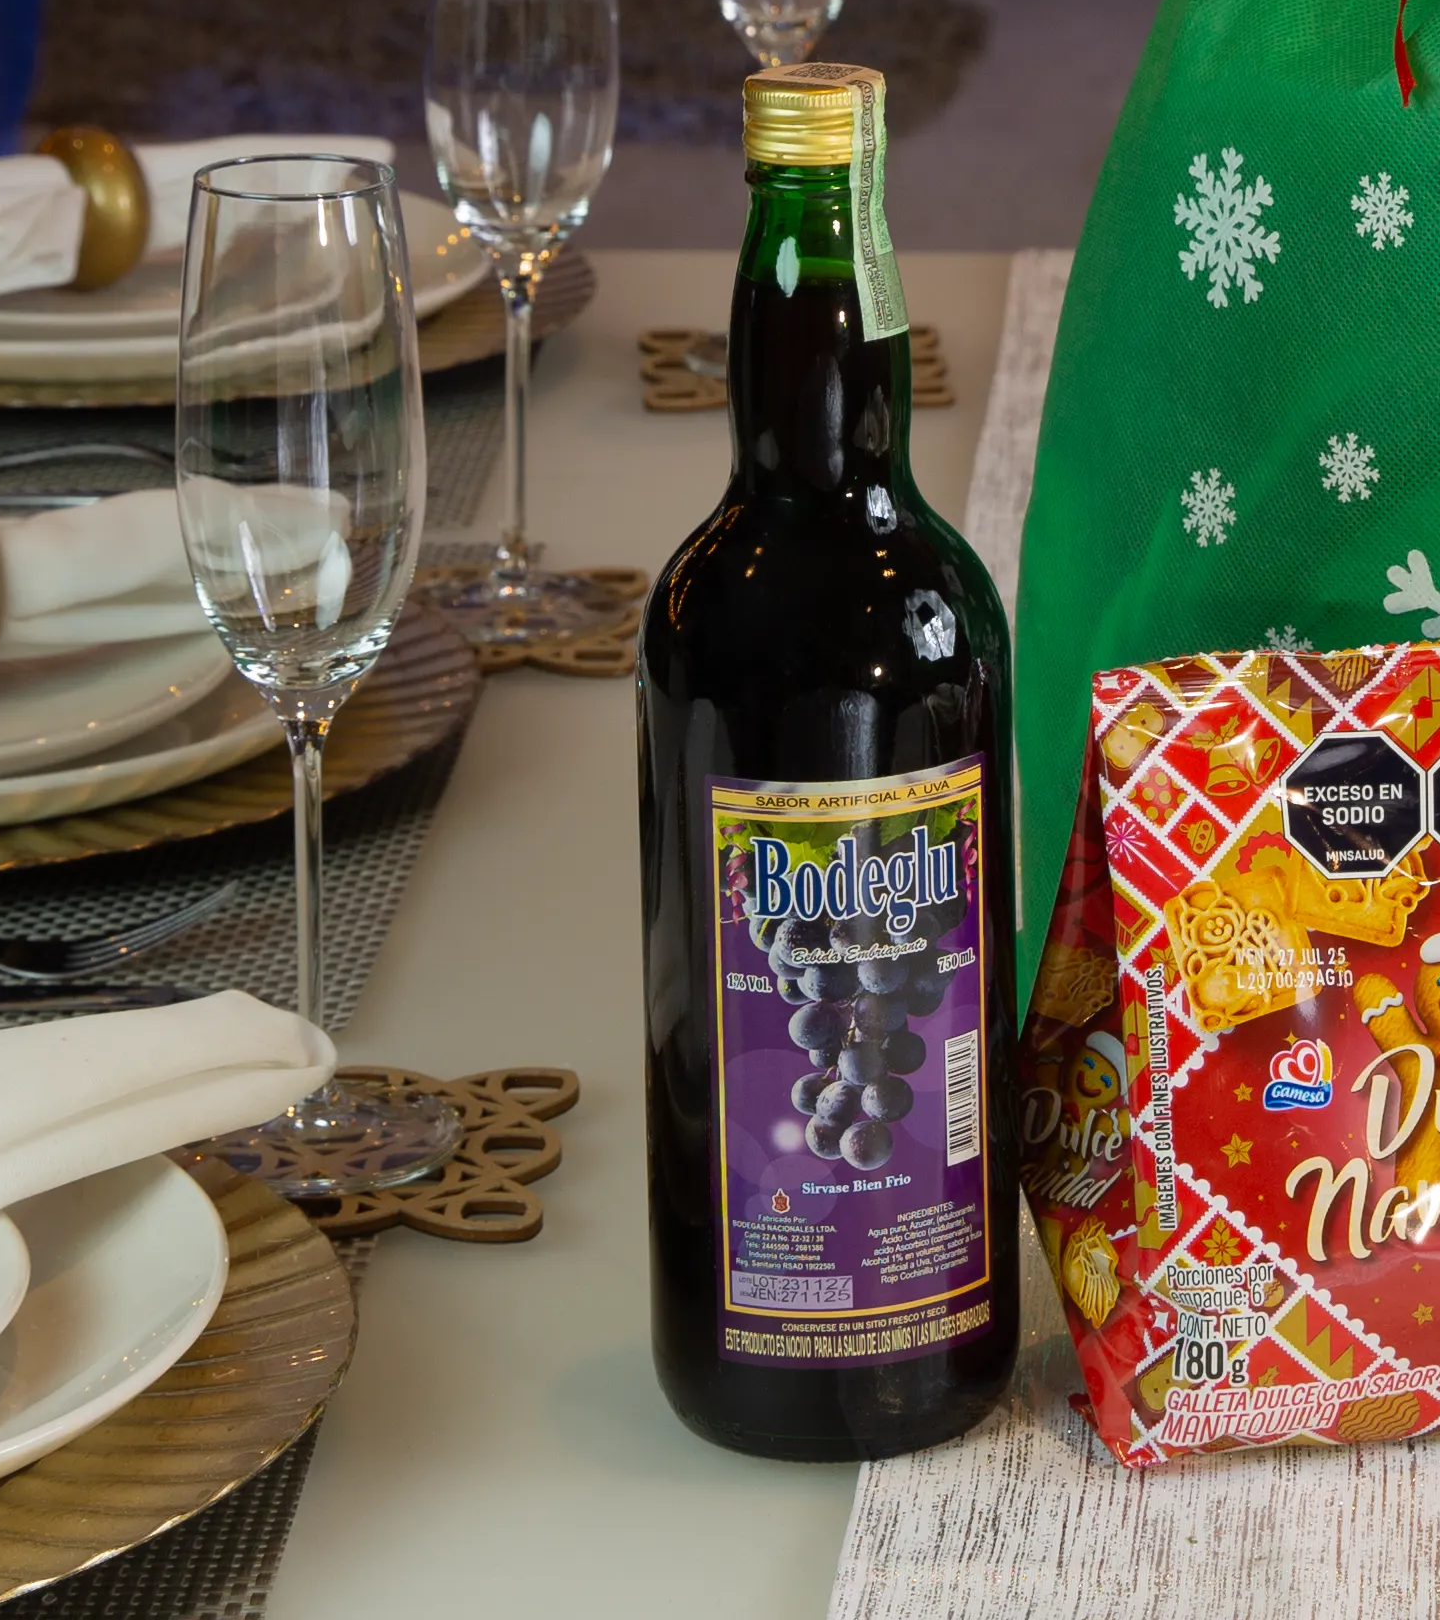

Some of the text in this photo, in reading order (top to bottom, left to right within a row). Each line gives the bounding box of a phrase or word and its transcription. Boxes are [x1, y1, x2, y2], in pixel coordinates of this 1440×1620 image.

[755, 780, 950, 808] SABOR ARTIFICIAL A UVA
[1304, 784, 1403, 804] EXCESO EN
[1322, 805, 1385, 826] SODIO
[1326, 849, 1385, 862] MINSALUD
[750, 825, 958, 935] Bodeglu
[792, 937, 928, 964] Bebida Embriagante
[1236, 946, 1346, 966] VEN 27 JUL 25
[937, 955, 958, 973] 750
[727, 973, 773, 993] 1% Vol.
[1146, 963, 1176, 1230] IMÁGENES CON FINES ILUSTRATIVOS.
[1271, 1083, 1325, 1104] Gamesa
[1022, 1087, 1123, 1161] Dulce
[802, 1174, 912, 1194] Sirvase Bien Frio
[1019, 1162, 1122, 1209] avidad
[732, 1220, 766, 1231] BODEGAS
[767, 1224, 815, 1233] NACIONALES
[758, 1214, 791, 1224] Fabricado
[867, 1228, 888, 1238] Agua
[881, 1234, 902, 1245] Acido
[748, 1250, 820, 1261] Industria Colombiana
[861, 1256, 890, 1267] Alcohol
[947, 1237, 964, 1249] sabor
[873, 1244, 895, 1256] acido
[895, 1238, 929, 1252] Ascorbico
[735, 1257, 750, 1267] Reg.
[751, 1260, 781, 1269] Sanitario
[880, 1273, 898, 1284] Rojo
[1166, 1264, 1274, 1286] Porciones por
[1171, 1283, 1262, 1311] empaque: 6
[725, 1299, 990, 1358] ESTE PRODUCTO ES NOCIVO PARA LA SALUD DE LOS NIÑOS Y LAS MUJERES EMBARAZADAS
[781, 1305, 947, 1332] CONSERVESE EN UN SITIO FRESCO Y SECO
[1178, 1312, 1266, 1339] CONT. NETO
[1174, 1337, 1246, 1383] 180 g
[1168, 1390, 1247, 1413] GALLETA
[1254, 1385, 1319, 1409] DULCE
[1322, 1379, 1370, 1402] CON
[1162, 1404, 1338, 1444] MANTEQUILLA
